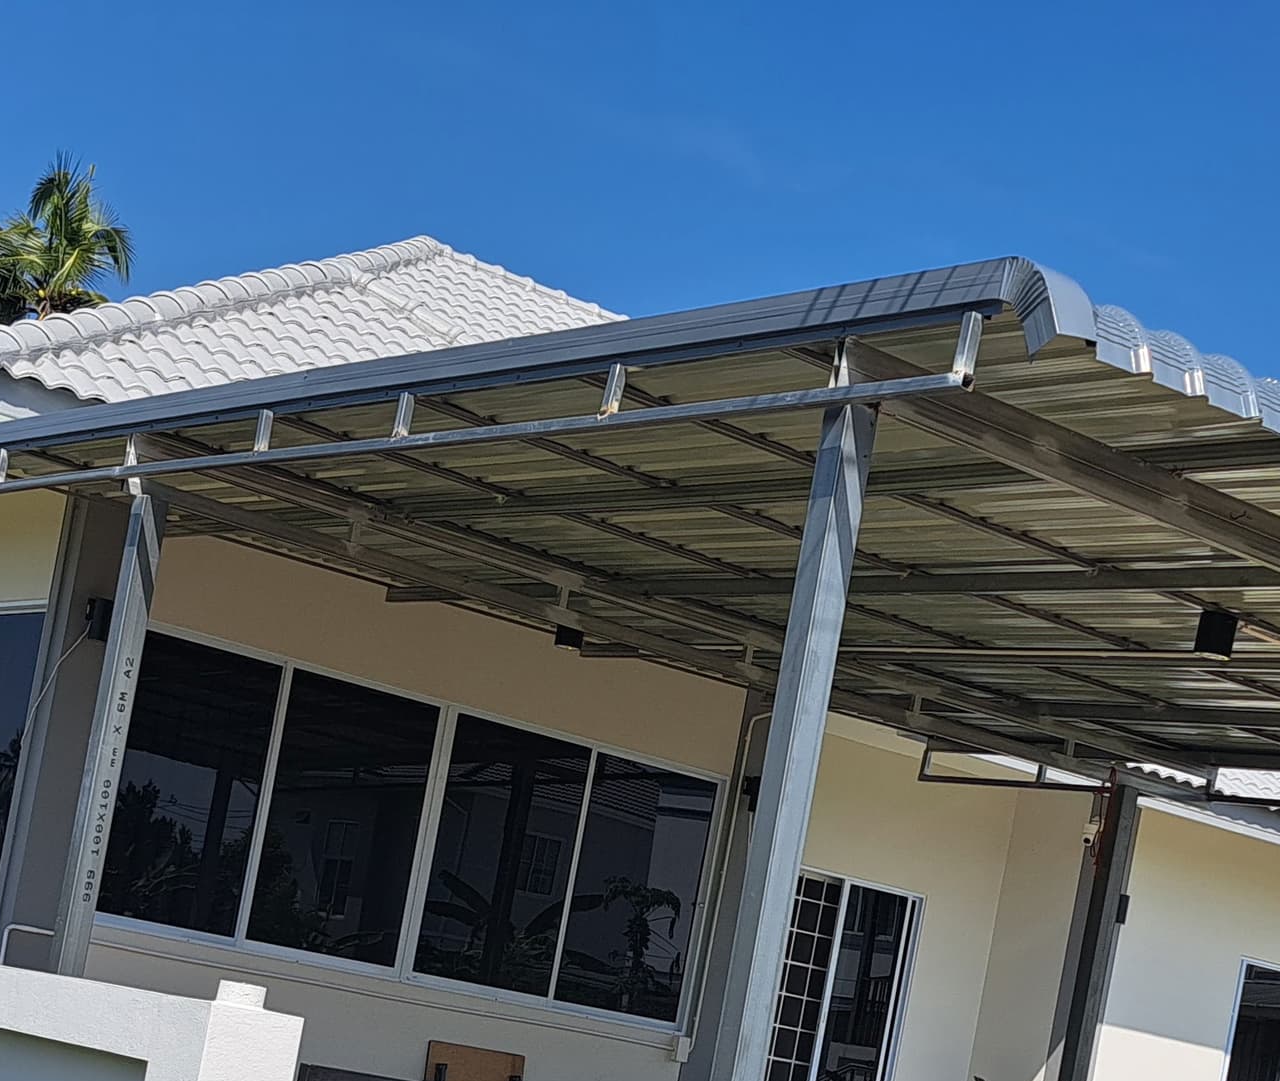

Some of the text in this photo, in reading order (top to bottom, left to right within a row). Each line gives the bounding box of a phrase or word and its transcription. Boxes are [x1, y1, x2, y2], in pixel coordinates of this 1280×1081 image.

[82, 870, 96, 903] 999
[91, 779, 111, 856] 100X100
[109, 747, 119, 768] mm
[117, 692, 129, 713] 6M
[124, 657, 135, 679] A2
